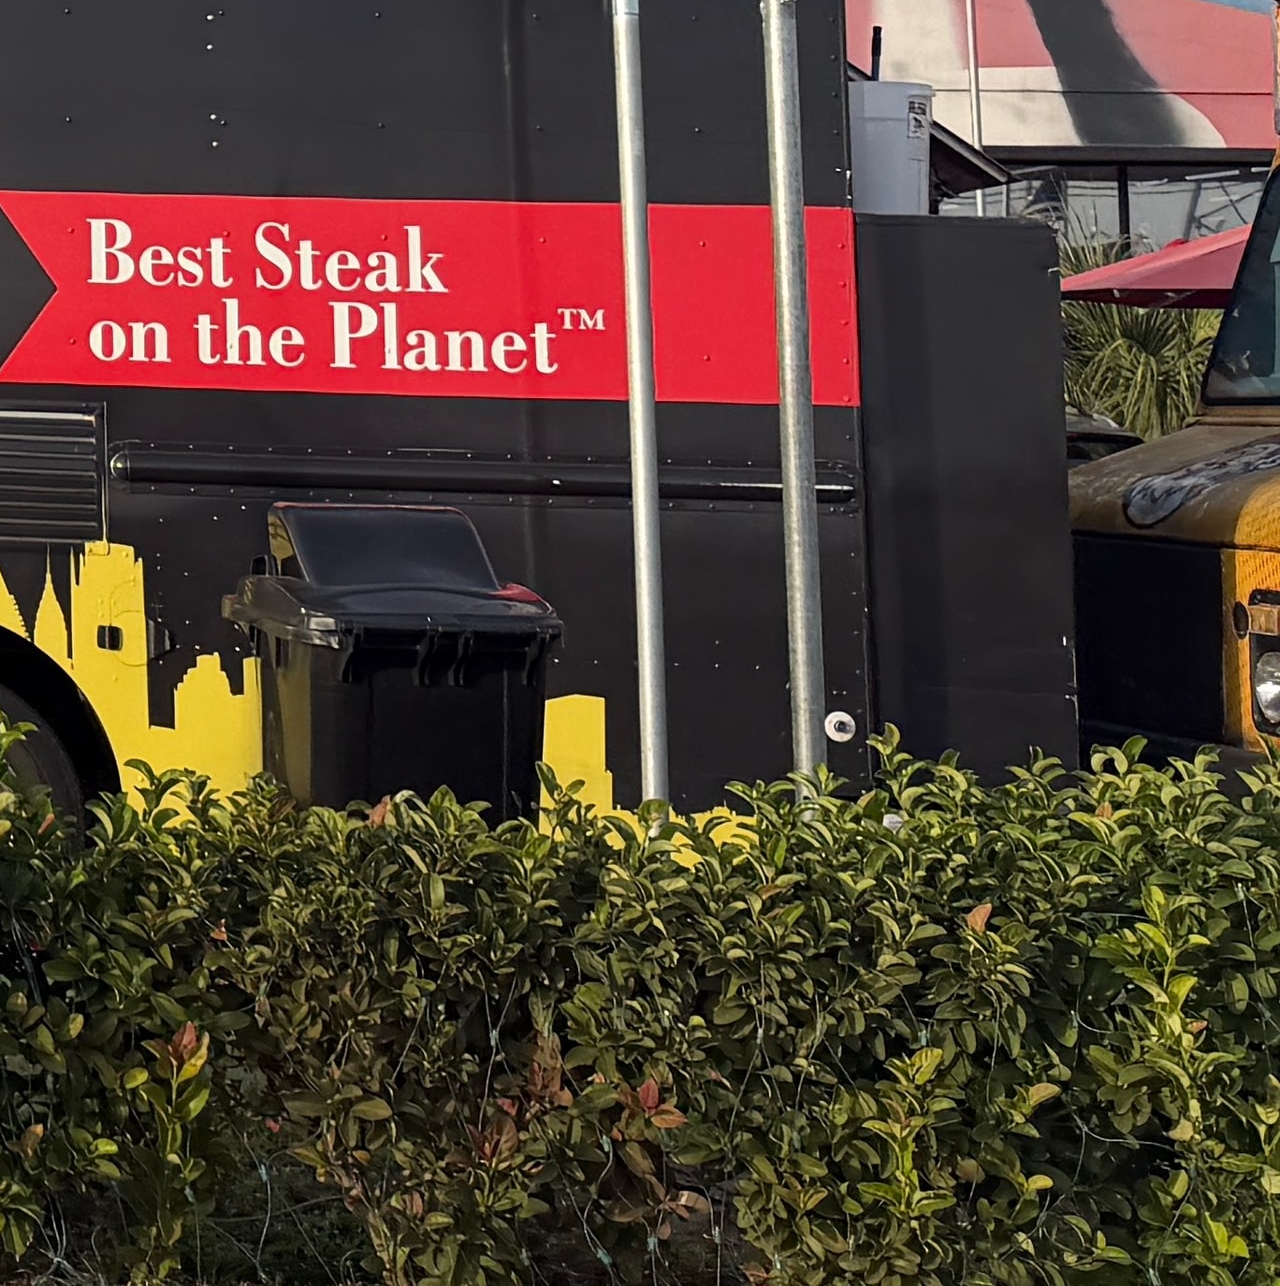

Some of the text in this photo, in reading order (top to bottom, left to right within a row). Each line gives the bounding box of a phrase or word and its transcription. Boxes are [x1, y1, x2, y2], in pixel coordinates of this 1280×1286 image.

[87, 217, 449, 294] Best Steak
[88, 319, 172, 364] on
[195, 298, 305, 368] the
